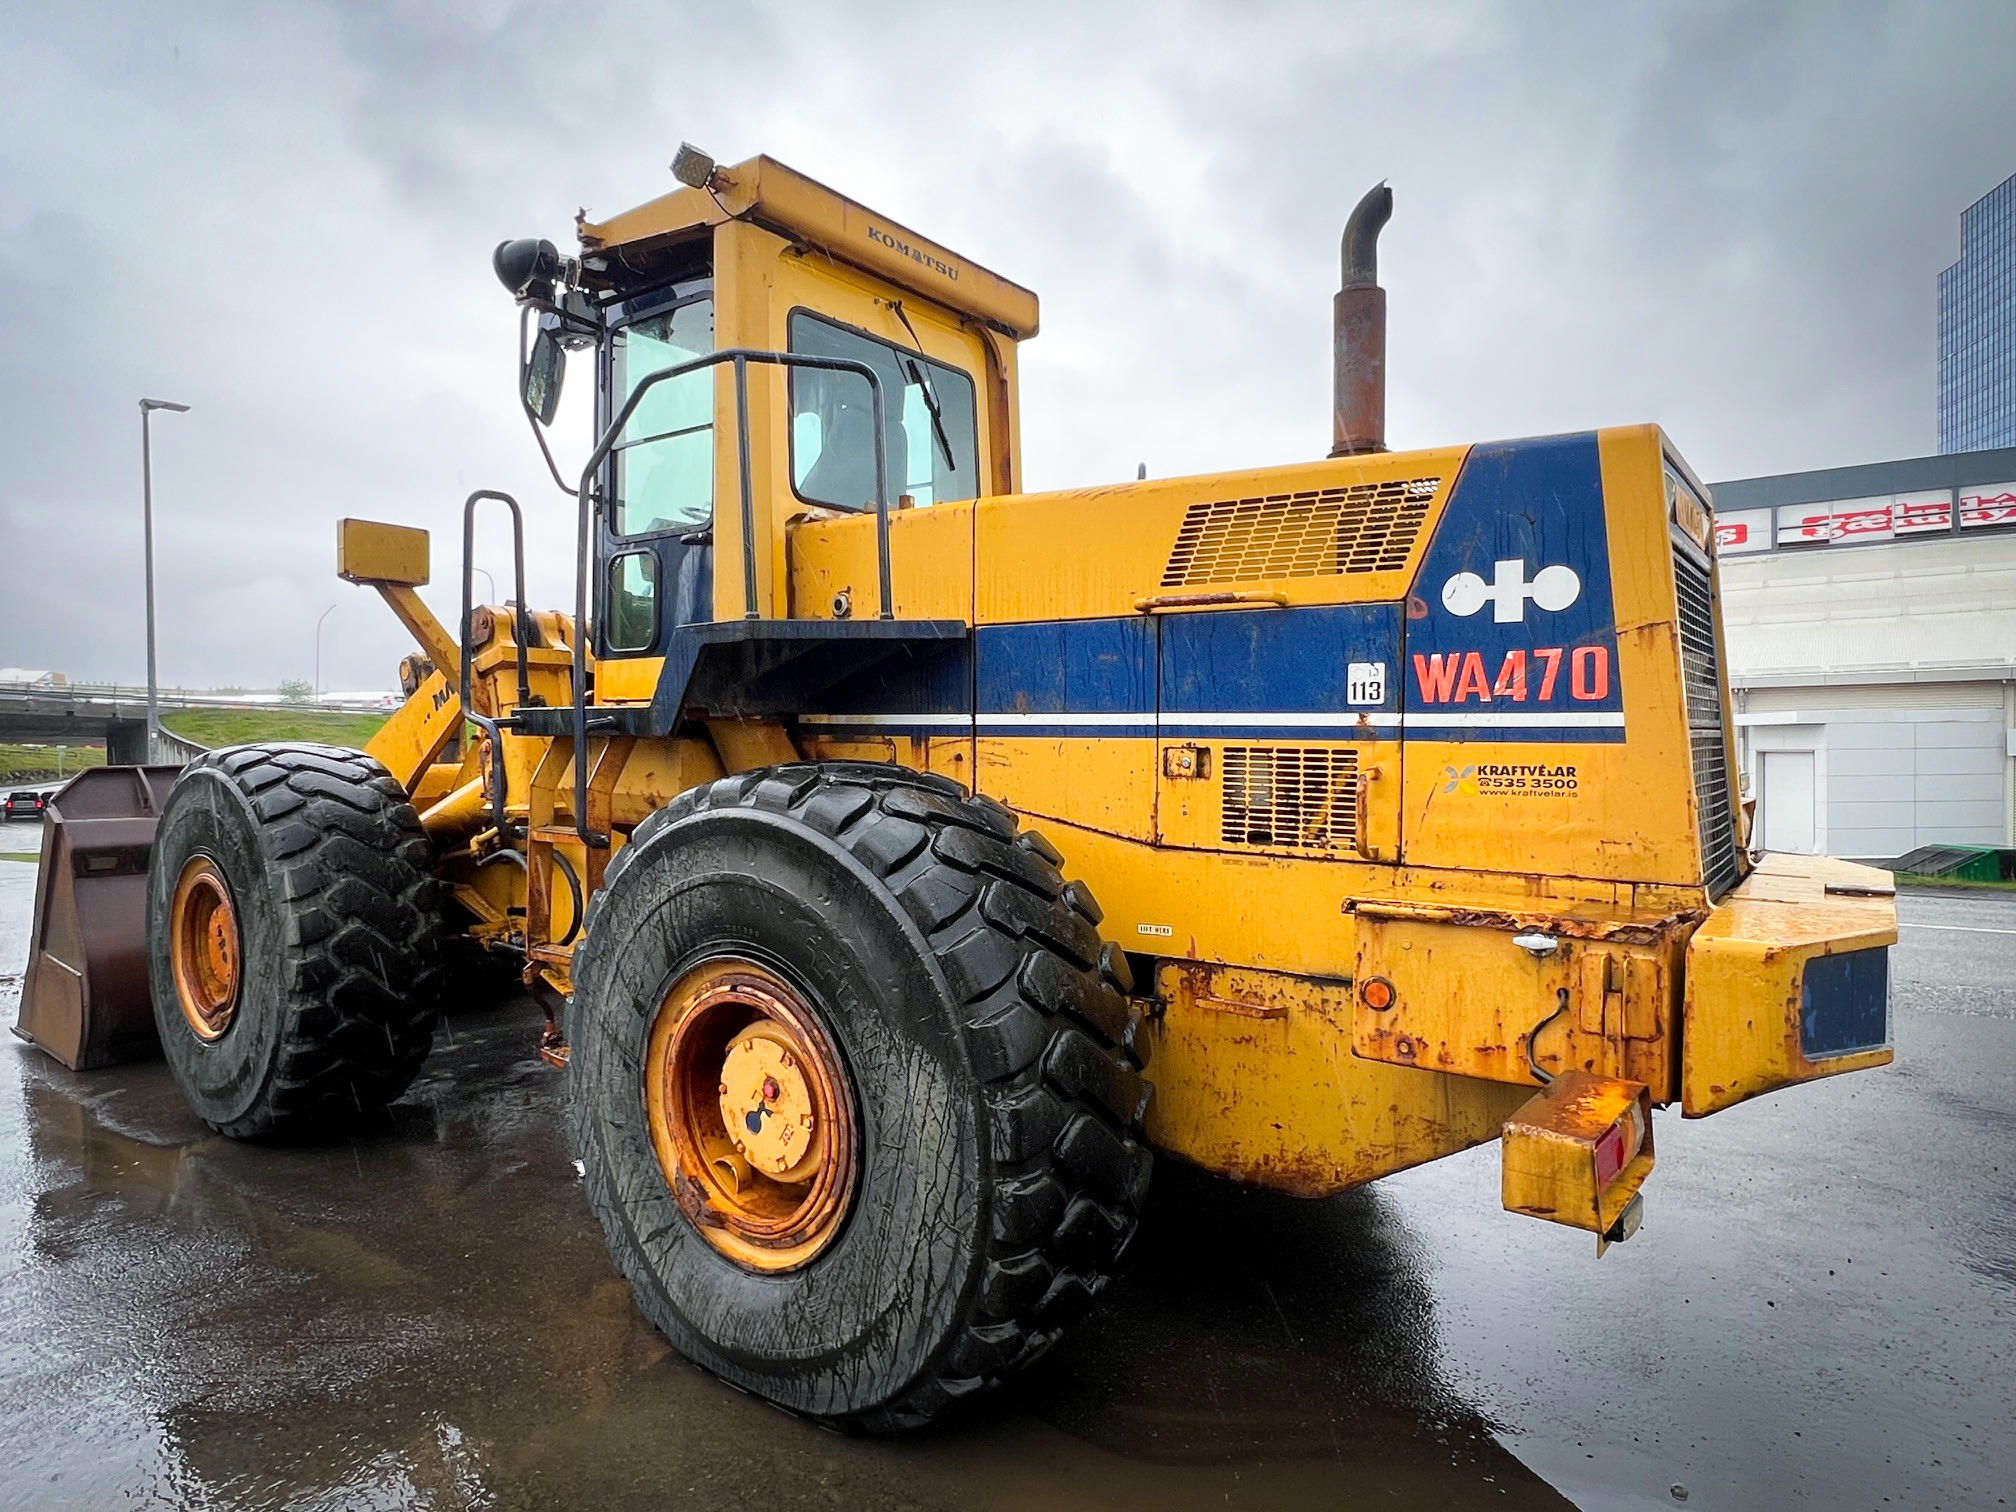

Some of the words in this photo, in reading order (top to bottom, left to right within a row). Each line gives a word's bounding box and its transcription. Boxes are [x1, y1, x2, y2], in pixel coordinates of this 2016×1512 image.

[867, 226, 959, 282] KOMATSU
[1413, 646, 1609, 703] WA470
[1351, 681, 1381, 700] 113
[1477, 764, 1577, 777] KRAFTVÉLAR
[1493, 778, 1527, 788] 535
[1530, 779, 1578, 789] 3500
[1479, 789, 1579, 798] www.kraftvelar.is
